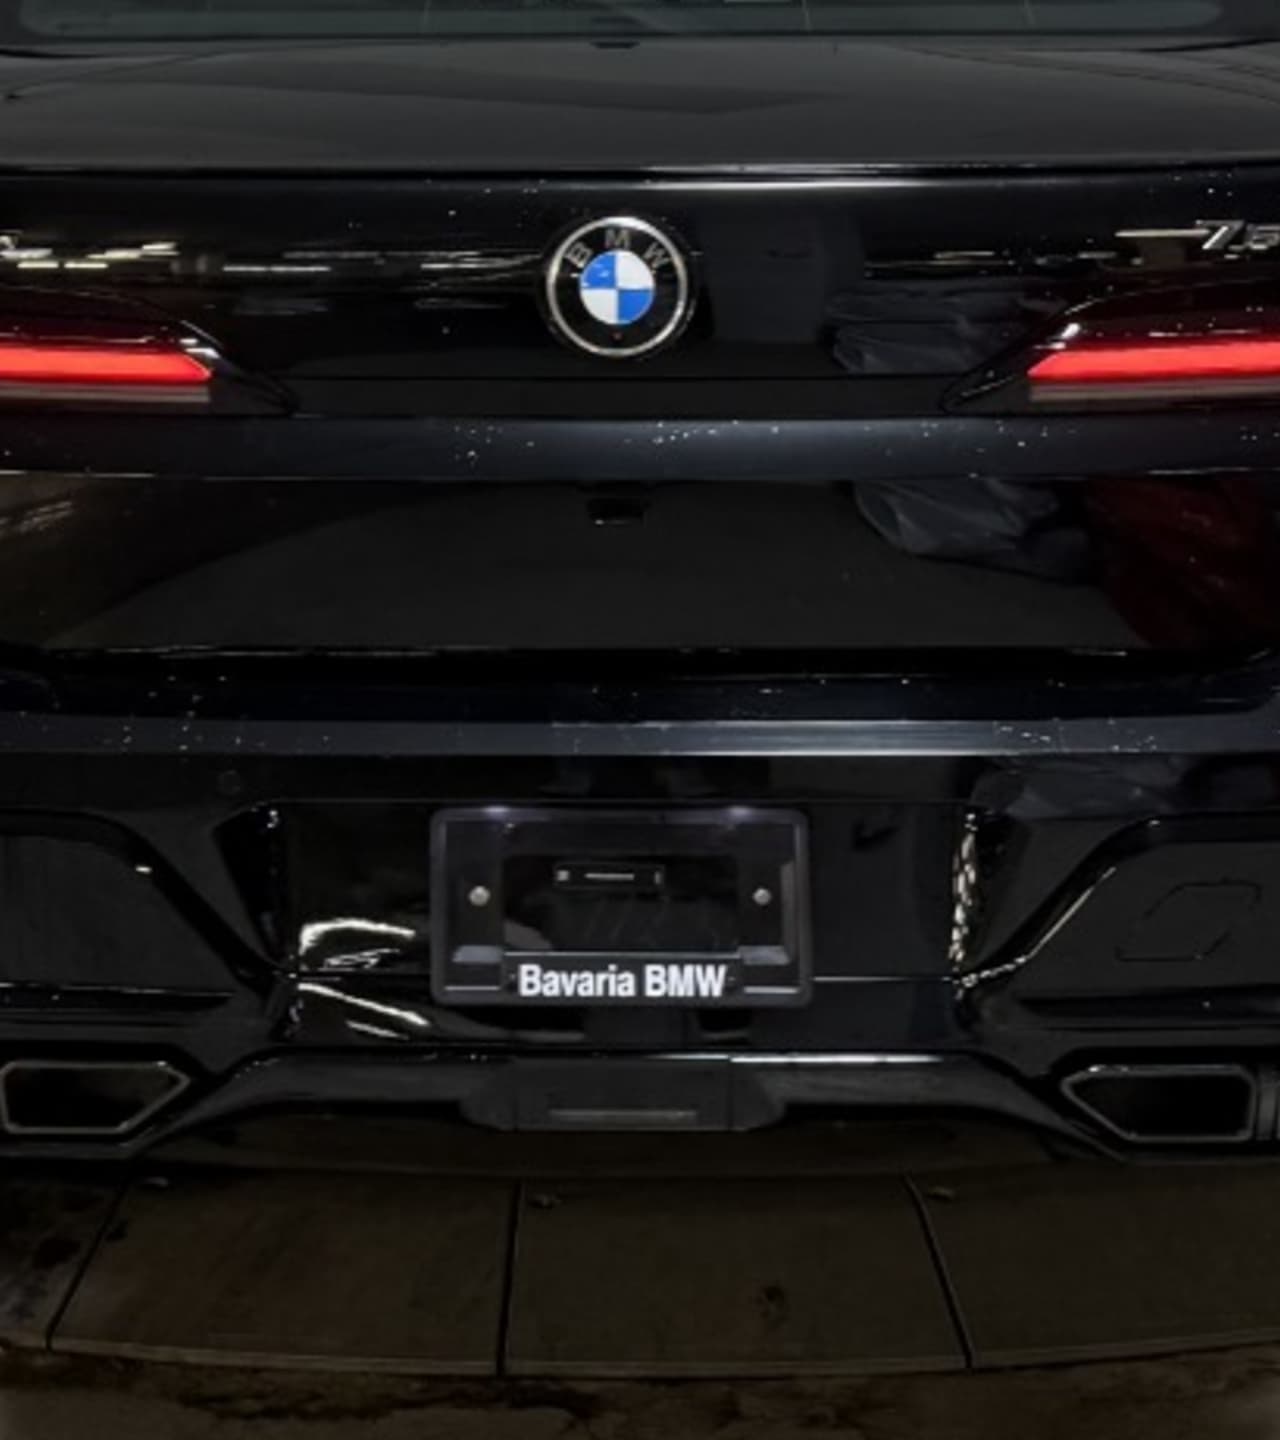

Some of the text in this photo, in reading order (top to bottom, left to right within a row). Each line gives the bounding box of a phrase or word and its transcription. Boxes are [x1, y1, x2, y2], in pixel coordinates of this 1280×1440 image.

[563, 228, 671, 269] BMW
[519, 964, 726, 997] Bavaria BMW
